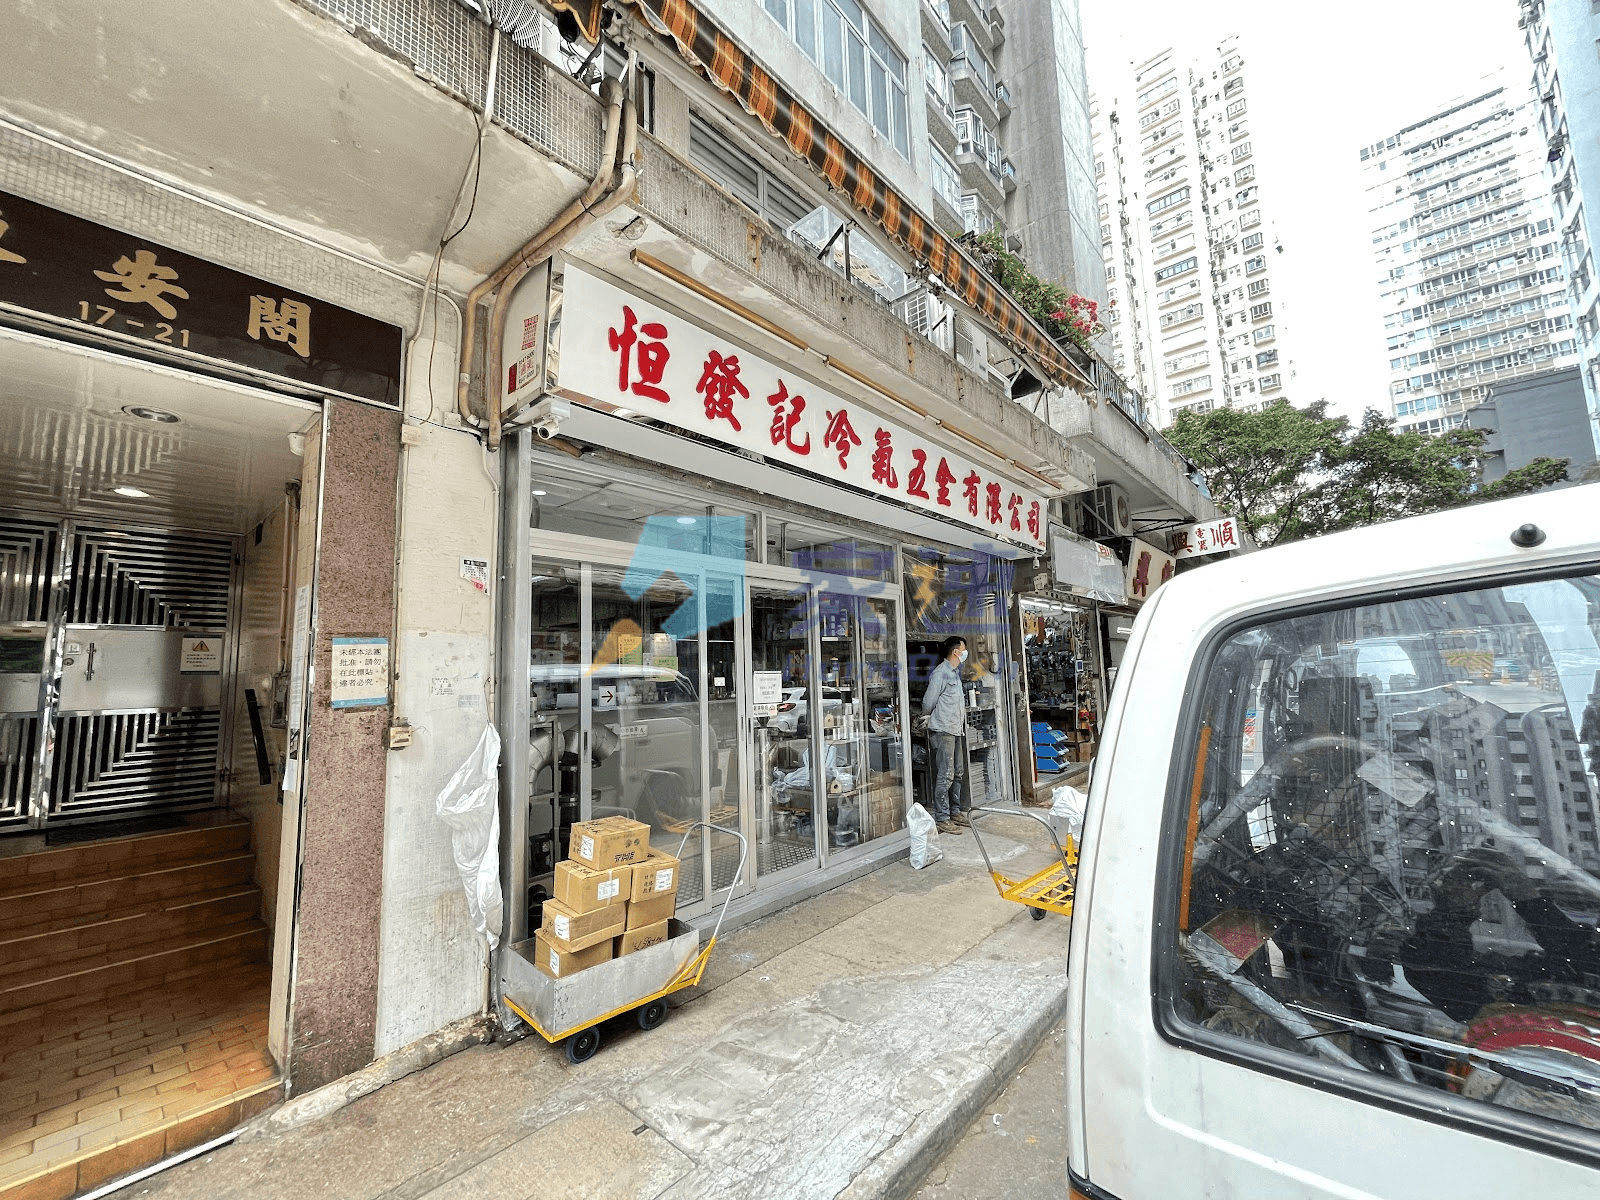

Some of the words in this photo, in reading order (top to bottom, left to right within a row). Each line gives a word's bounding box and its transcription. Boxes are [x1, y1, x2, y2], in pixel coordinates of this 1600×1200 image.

[0, 209, 311, 358] 安閣
[607, 304, 1043, 541] 恒發記冷氣五金有限公司
